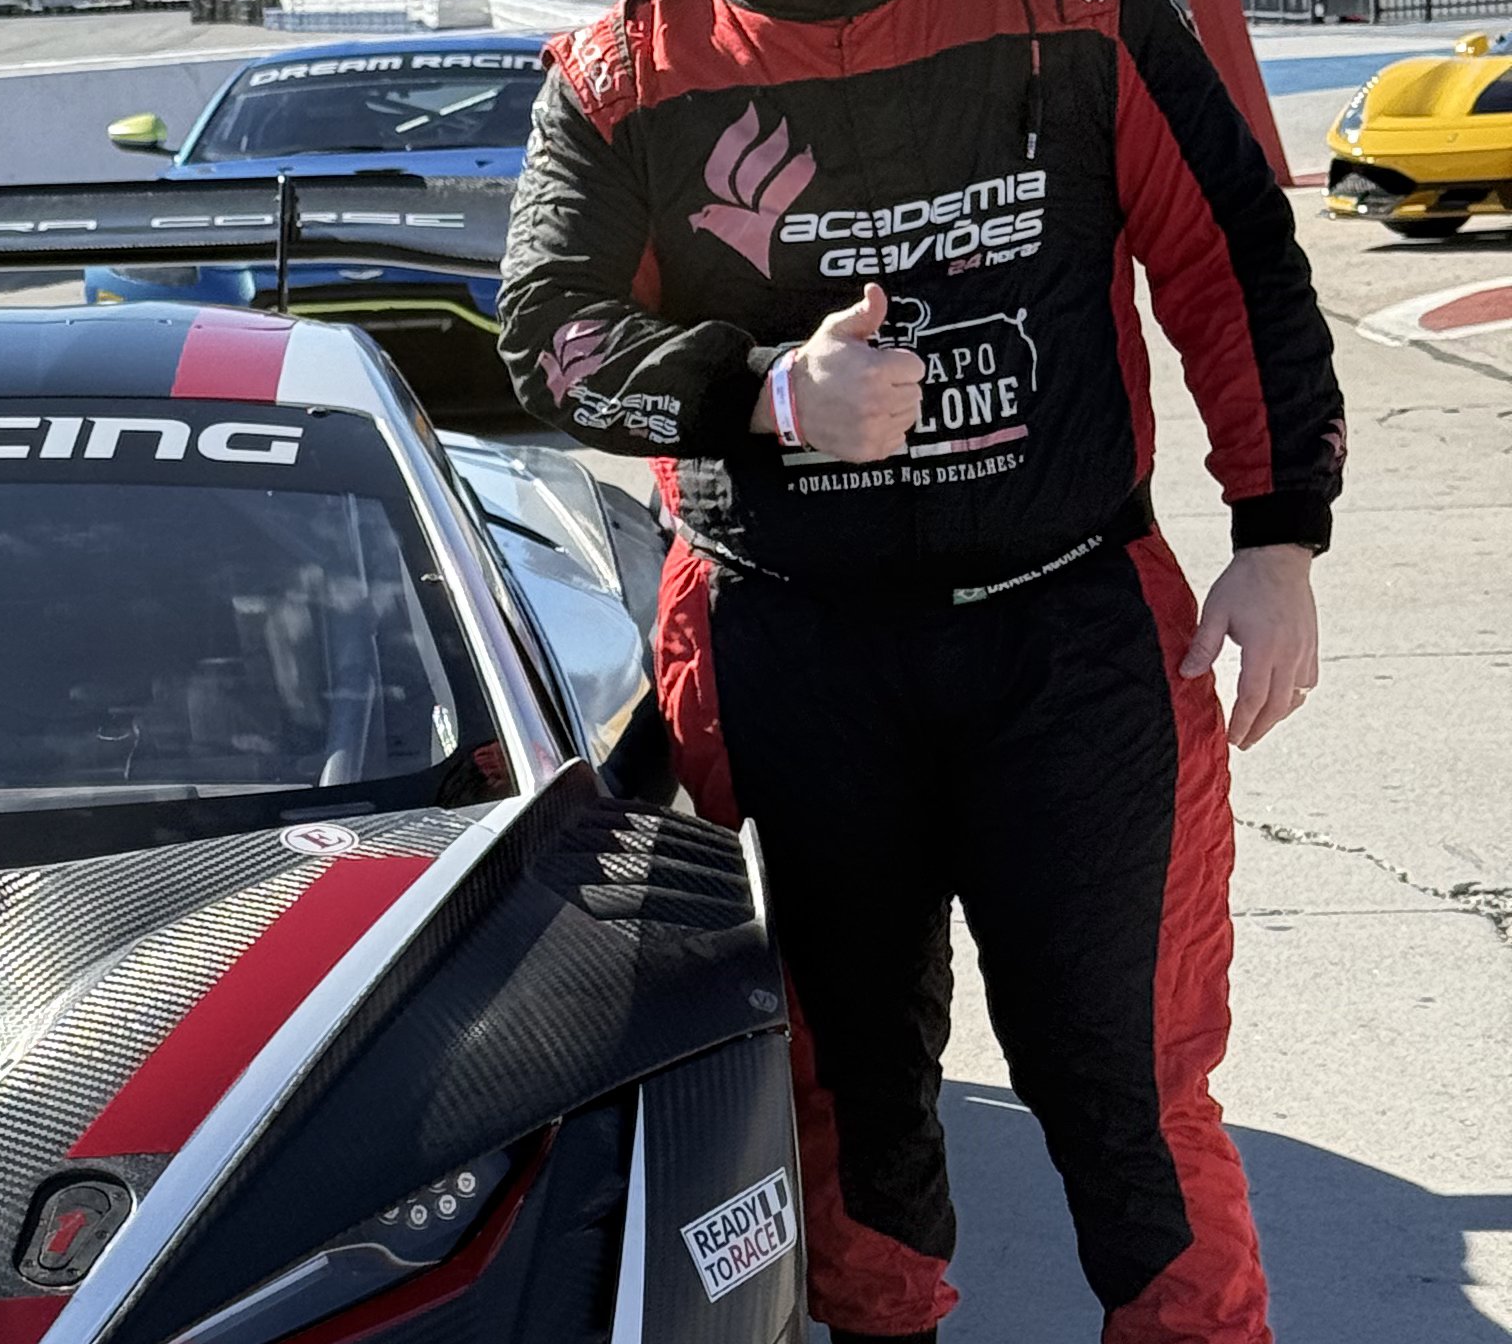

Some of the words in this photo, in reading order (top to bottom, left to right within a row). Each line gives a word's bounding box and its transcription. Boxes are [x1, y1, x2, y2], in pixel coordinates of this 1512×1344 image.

[249, 55, 404, 87] DREAM
[411, 53, 542, 71] RACIN
[947, 254, 982, 276] 24
[798, 468, 896, 495] QUALIDADE
[901, 466, 931, 487] NOS
[936, 453, 1017, 484] DETALHES
[293, 828, 347, 850] E
[692, 1195, 761, 1259] READY
